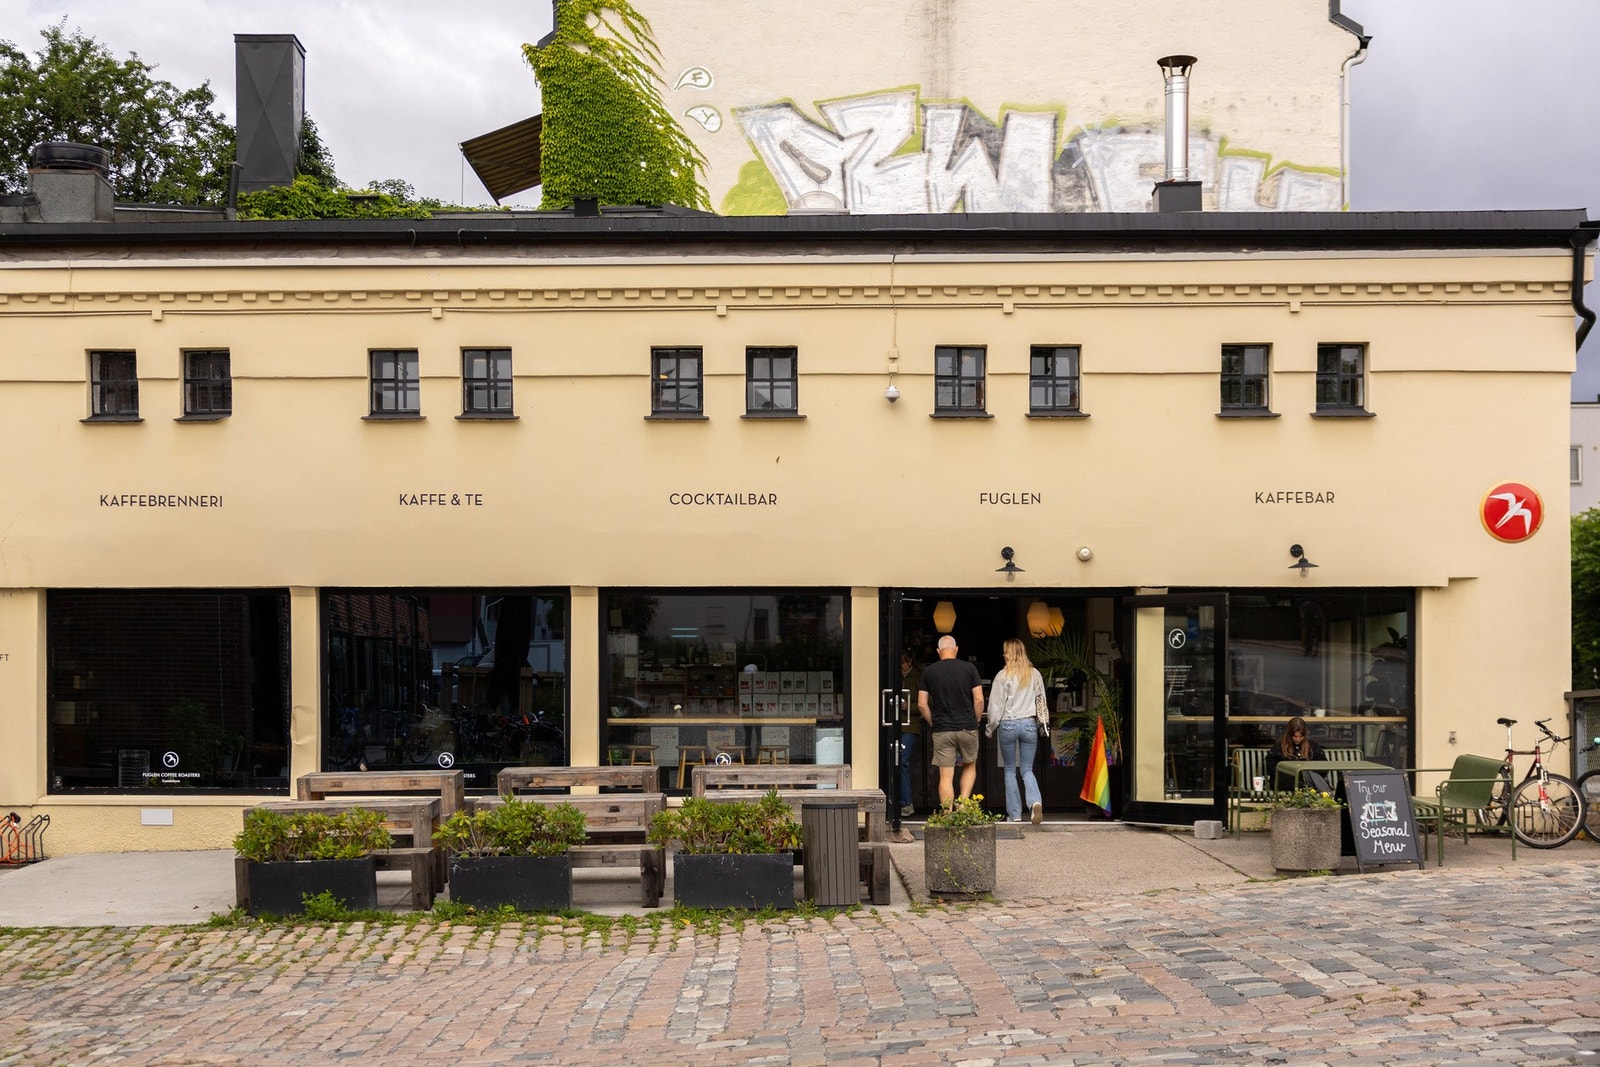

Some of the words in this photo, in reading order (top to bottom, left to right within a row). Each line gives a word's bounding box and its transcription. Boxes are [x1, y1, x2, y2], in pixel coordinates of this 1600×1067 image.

[99, 494, 223, 508] KAFFEBRENNERI
[399, 493, 447, 506] KAFFE
[450, 493, 461, 506] &
[464, 493, 483, 506] TE
[669, 492, 778, 506] COCKTAILBAR
[979, 492, 1042, 505] FUGLEN
[1255, 491, 1335, 504] KAFFEBAR
[1353, 780, 1372, 802] Try
[1372, 784, 1387, 793] our
[1365, 803, 1396, 819] NEW
[1360, 820, 1410, 839] Seasonal
[1373, 840, 1406, 854] Menu
